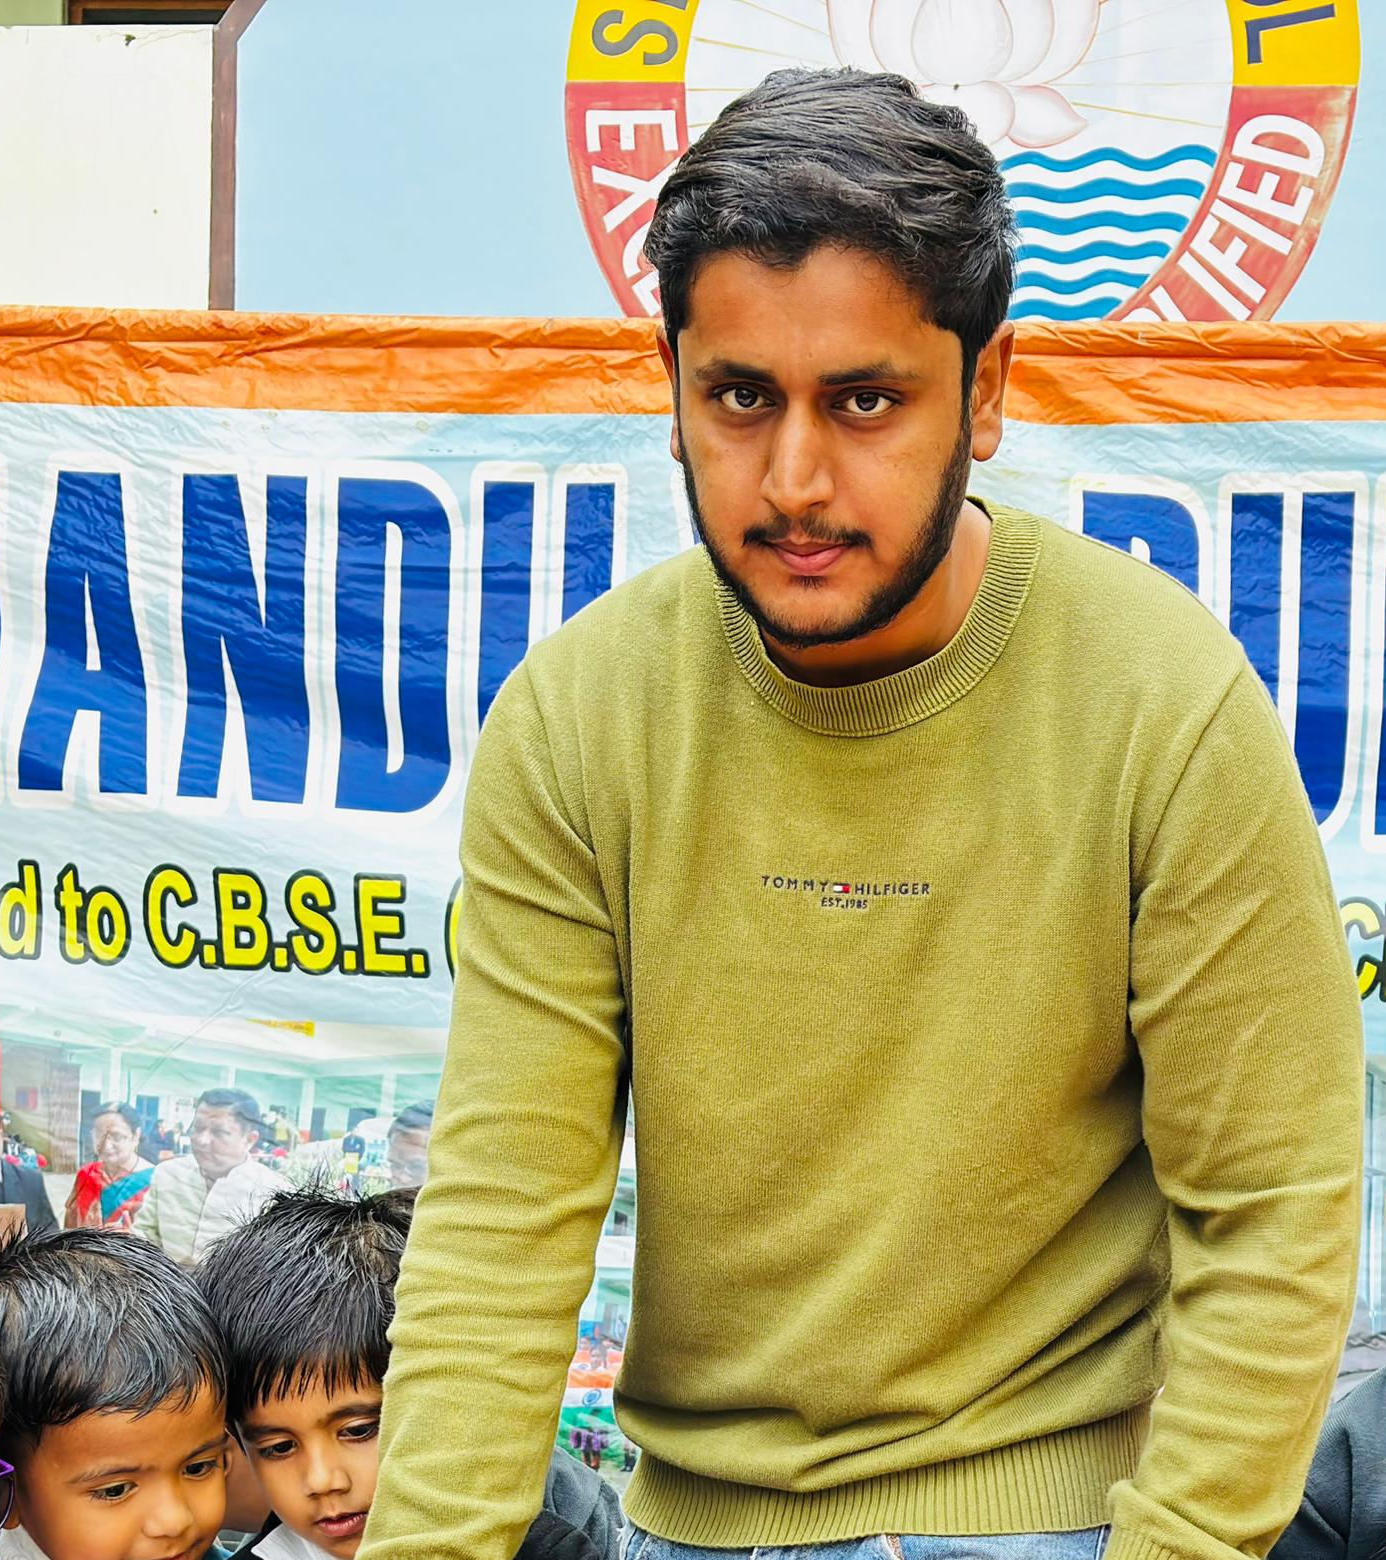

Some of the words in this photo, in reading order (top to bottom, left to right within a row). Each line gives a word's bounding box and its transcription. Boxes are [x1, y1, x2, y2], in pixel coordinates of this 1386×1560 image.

[762, 875, 828, 893] TOMMY
[855, 882, 930, 895] HILFIGER
[821, 897, 868, 910] EST.1985
[59, 870, 129, 962] to
[147, 870, 428, 976] C.B.S.E.
